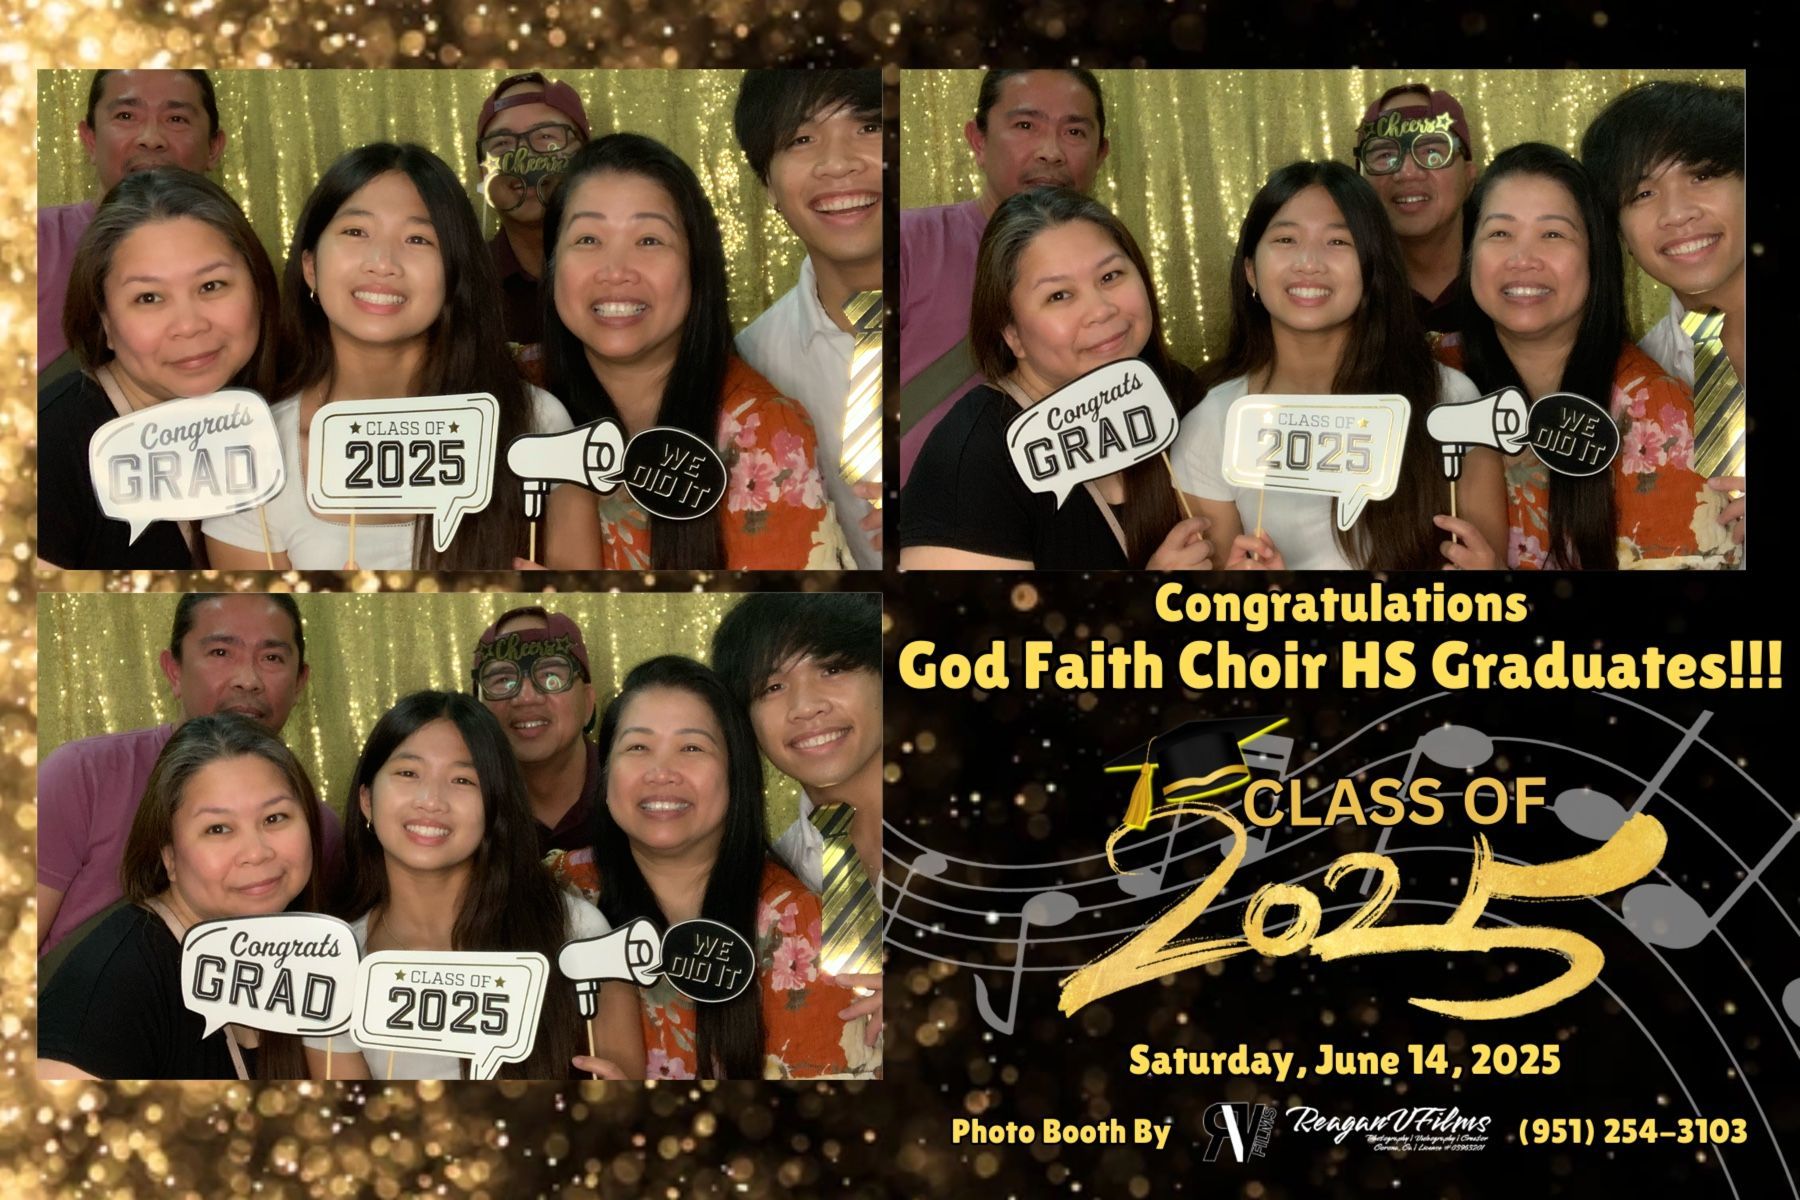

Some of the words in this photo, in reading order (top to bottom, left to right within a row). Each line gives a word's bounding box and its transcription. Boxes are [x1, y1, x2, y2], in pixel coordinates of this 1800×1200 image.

[1046, 371, 1144, 432] Congrats
[1277, 412, 1331, 428] CLASS
[1334, 415, 1355, 429] OF
[1560, 406, 1600, 437] WE
[140, 402, 254, 451] Congrats
[366, 420, 419, 436] CLASS
[425, 420, 446, 436] OF
[1023, 404, 1157, 482] GRAD
[1533, 427, 1580, 457] DID
[1578, 439, 1606, 466] IT
[344, 439, 466, 489] 2025
[662, 443, 706, 477] WE
[1256, 428, 1373, 474] 2025
[107, 444, 257, 505] GRAD
[628, 464, 680, 497] DID
[679, 476, 711, 509] IT
[229, 931, 342, 968] Congrats
[695, 933, 734, 961] WE
[192, 953, 337, 1021] GRAD
[410, 970, 465, 987] CLASS
[469, 974, 492, 989] OF
[668, 956, 717, 983] DID
[715, 966, 742, 990] IT
[386, 986, 510, 1037] 2025
